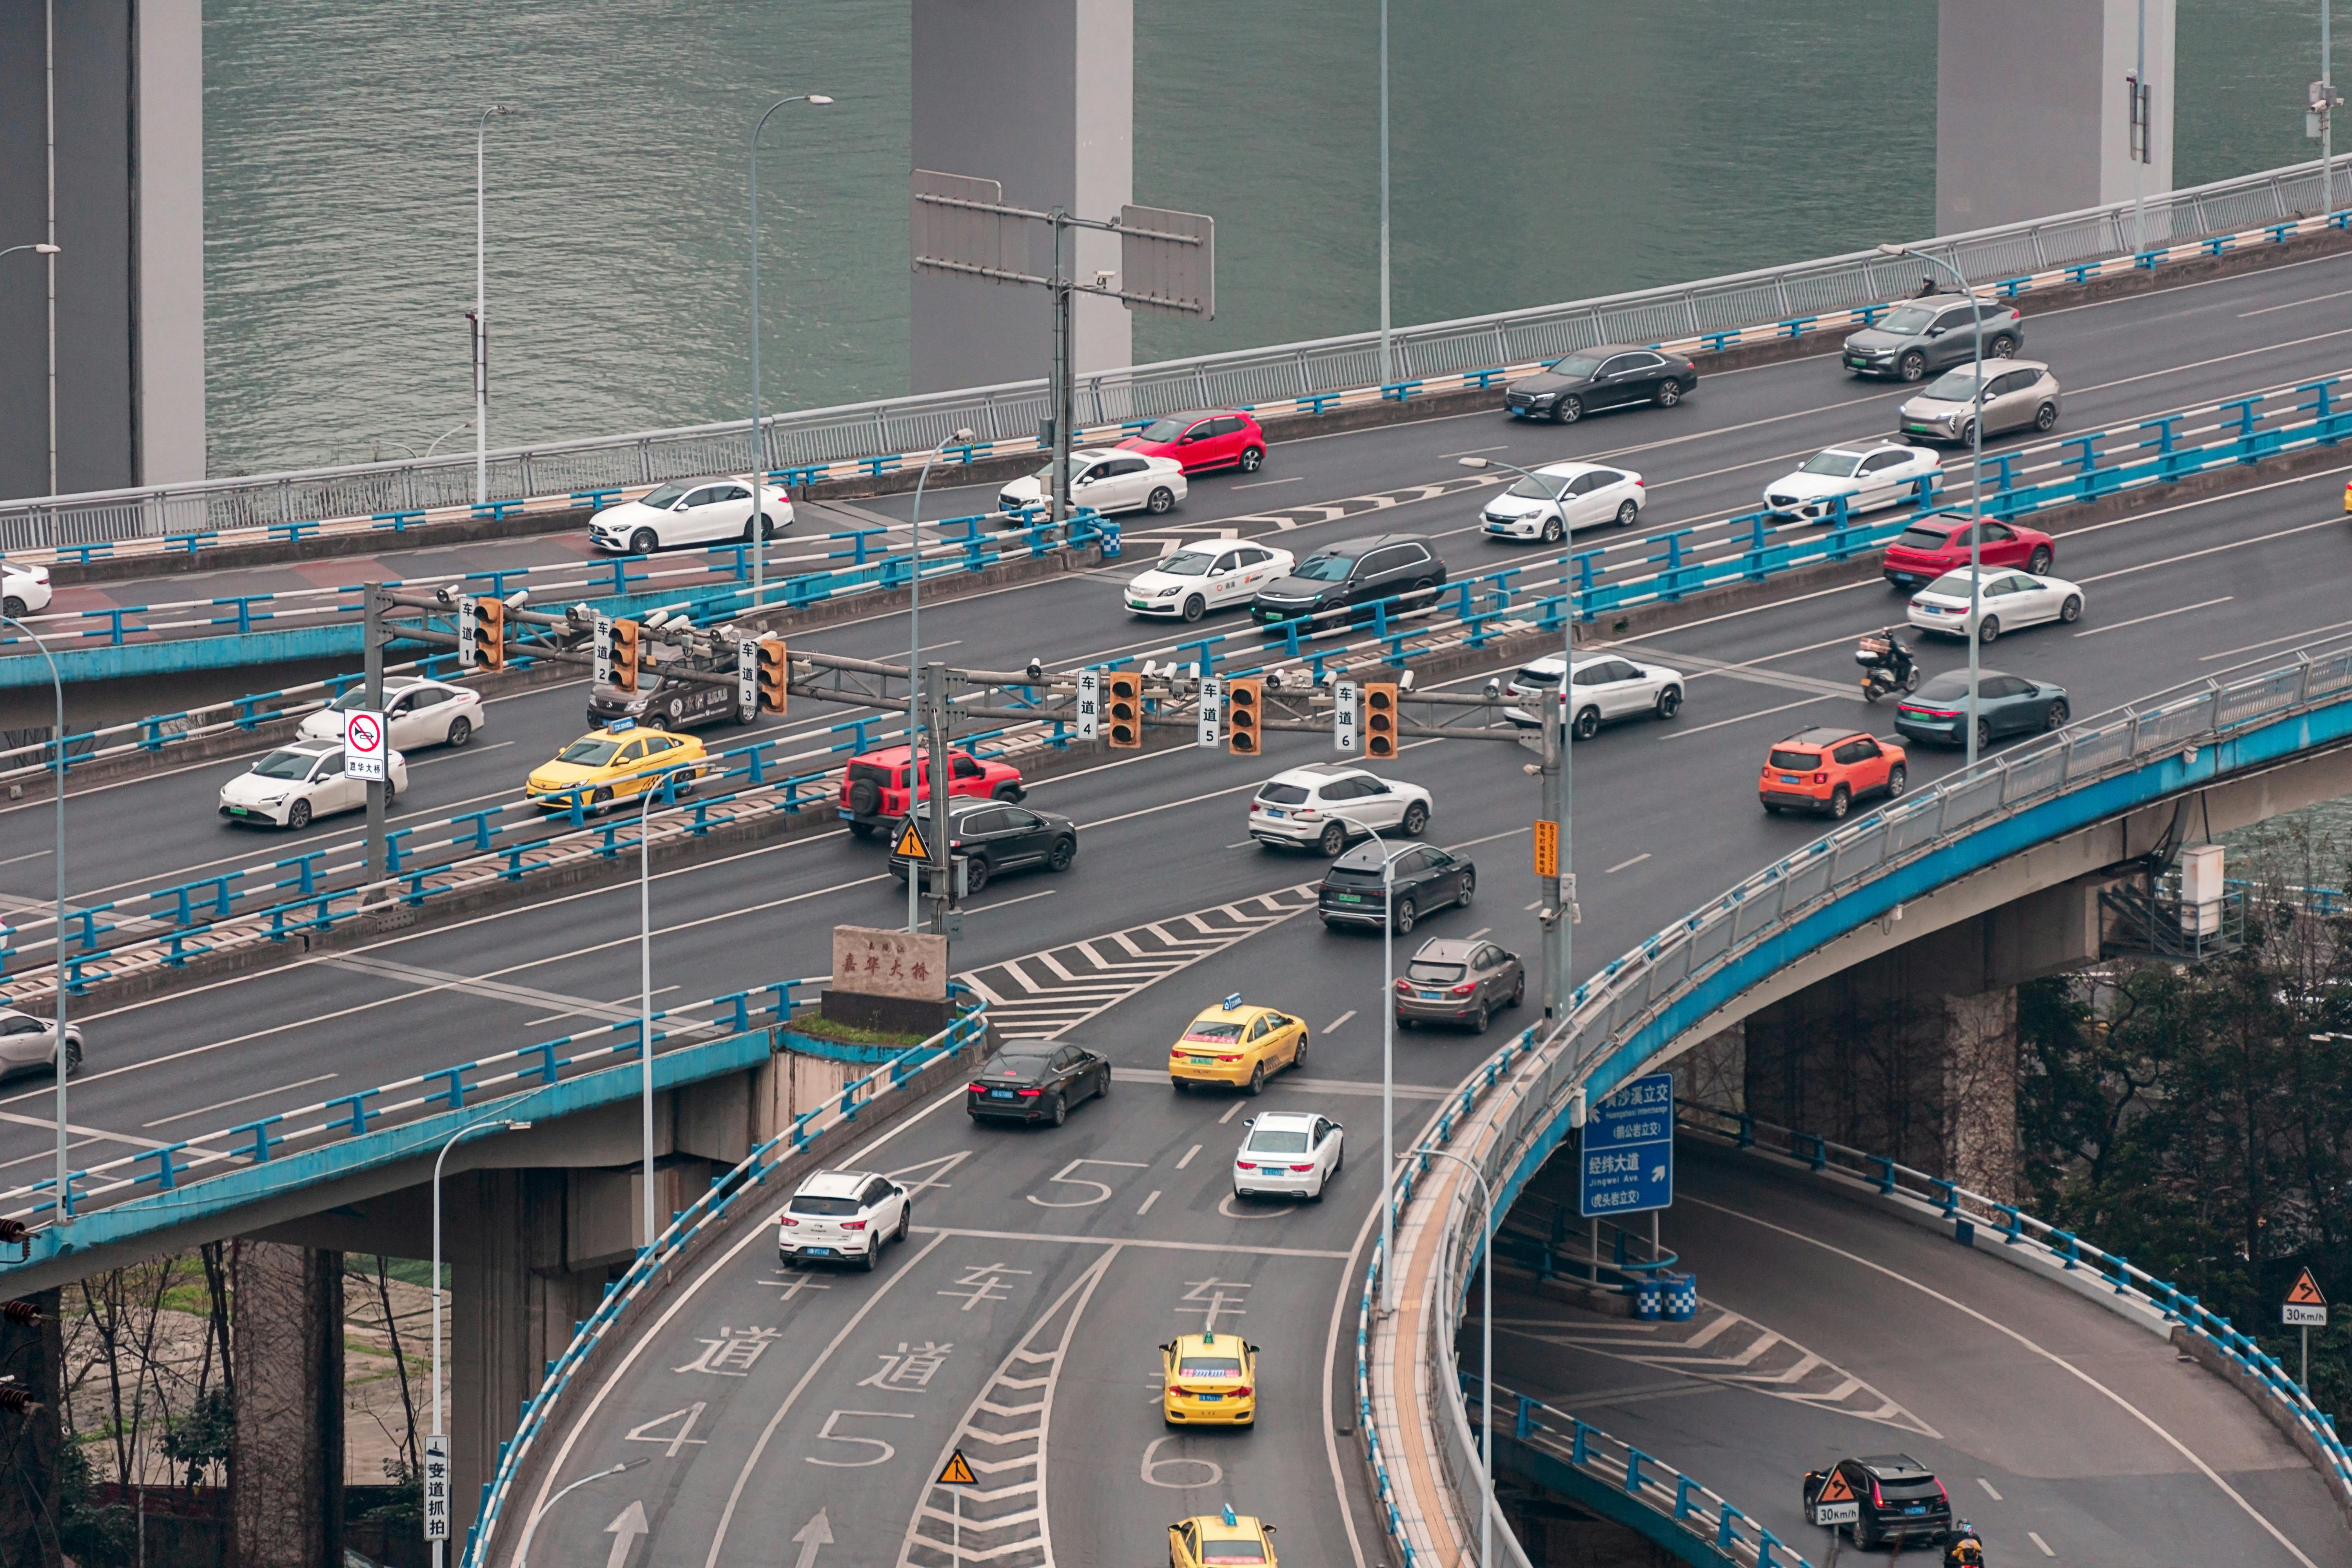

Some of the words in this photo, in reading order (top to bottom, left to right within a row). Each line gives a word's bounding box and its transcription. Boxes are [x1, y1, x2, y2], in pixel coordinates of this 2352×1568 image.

[462, 603, 473, 660] 车道1
[597, 621, 608, 679] 车道2
[742, 643, 753, 701] 车道3
[1081, 676, 1095, 735] 车道4
[1203, 683, 1217, 741] 车道5
[1339, 687, 1352, 746] 车道6
[350, 762, 381, 774] 嘉华大桥
[1027, 1158, 1149, 1207] 5
[1589, 1152, 1640, 1174] 经纬大道
[1589, 1176, 1619, 1187] Jingwei
[2287, 1308, 2324, 1321] 30Km/h
[428, 1463, 445, 1535] 变道抓拍
[1821, 1508, 1856, 1521] 30Km/h
